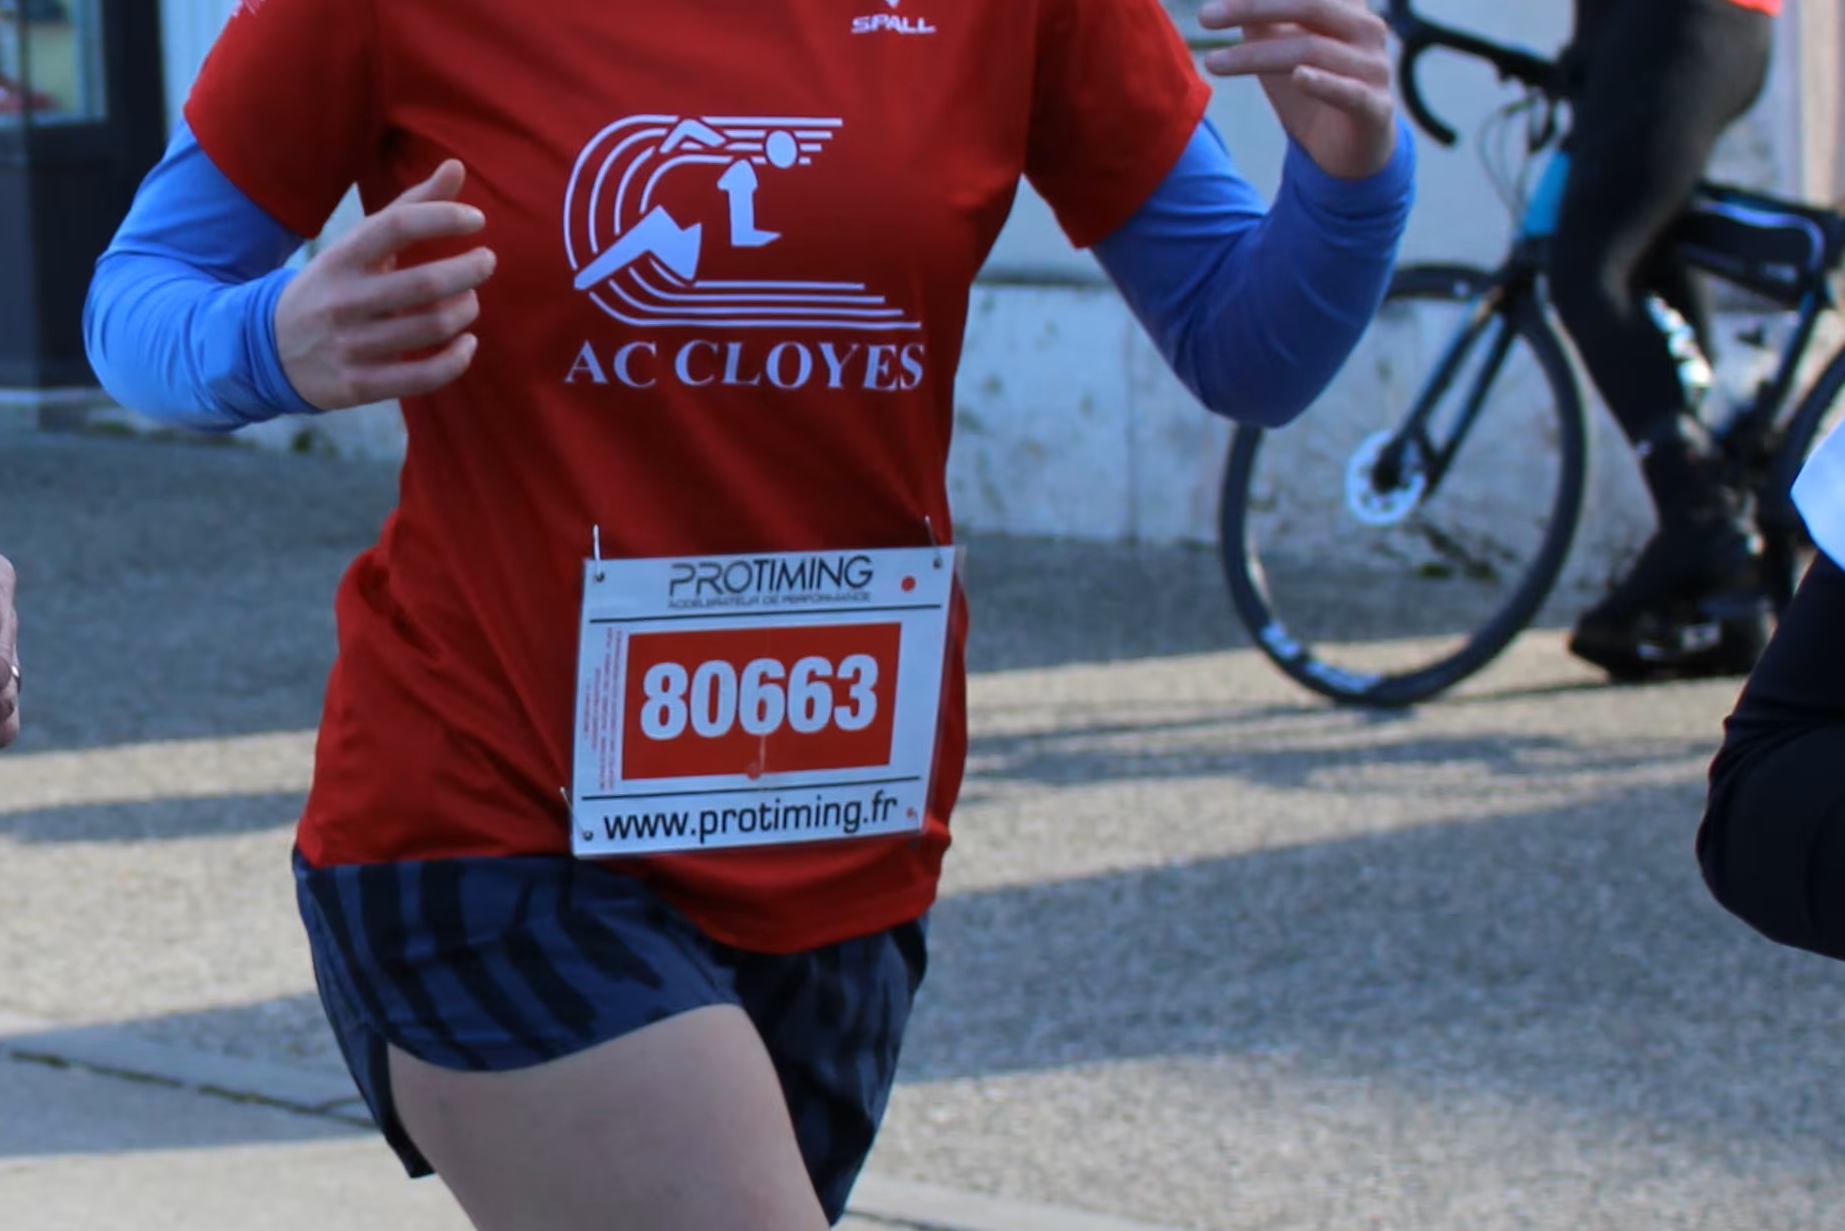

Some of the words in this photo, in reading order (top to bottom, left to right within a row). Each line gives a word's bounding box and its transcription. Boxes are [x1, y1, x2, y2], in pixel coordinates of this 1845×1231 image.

[850, 13, 937, 35] SPALL
[563, 340, 657, 390] AC
[673, 339, 926, 392] CLOYES
[669, 555, 874, 597] PROTIMING
[640, 654, 879, 741] 80663
[603, 789, 898, 845] www.protiming.fr
